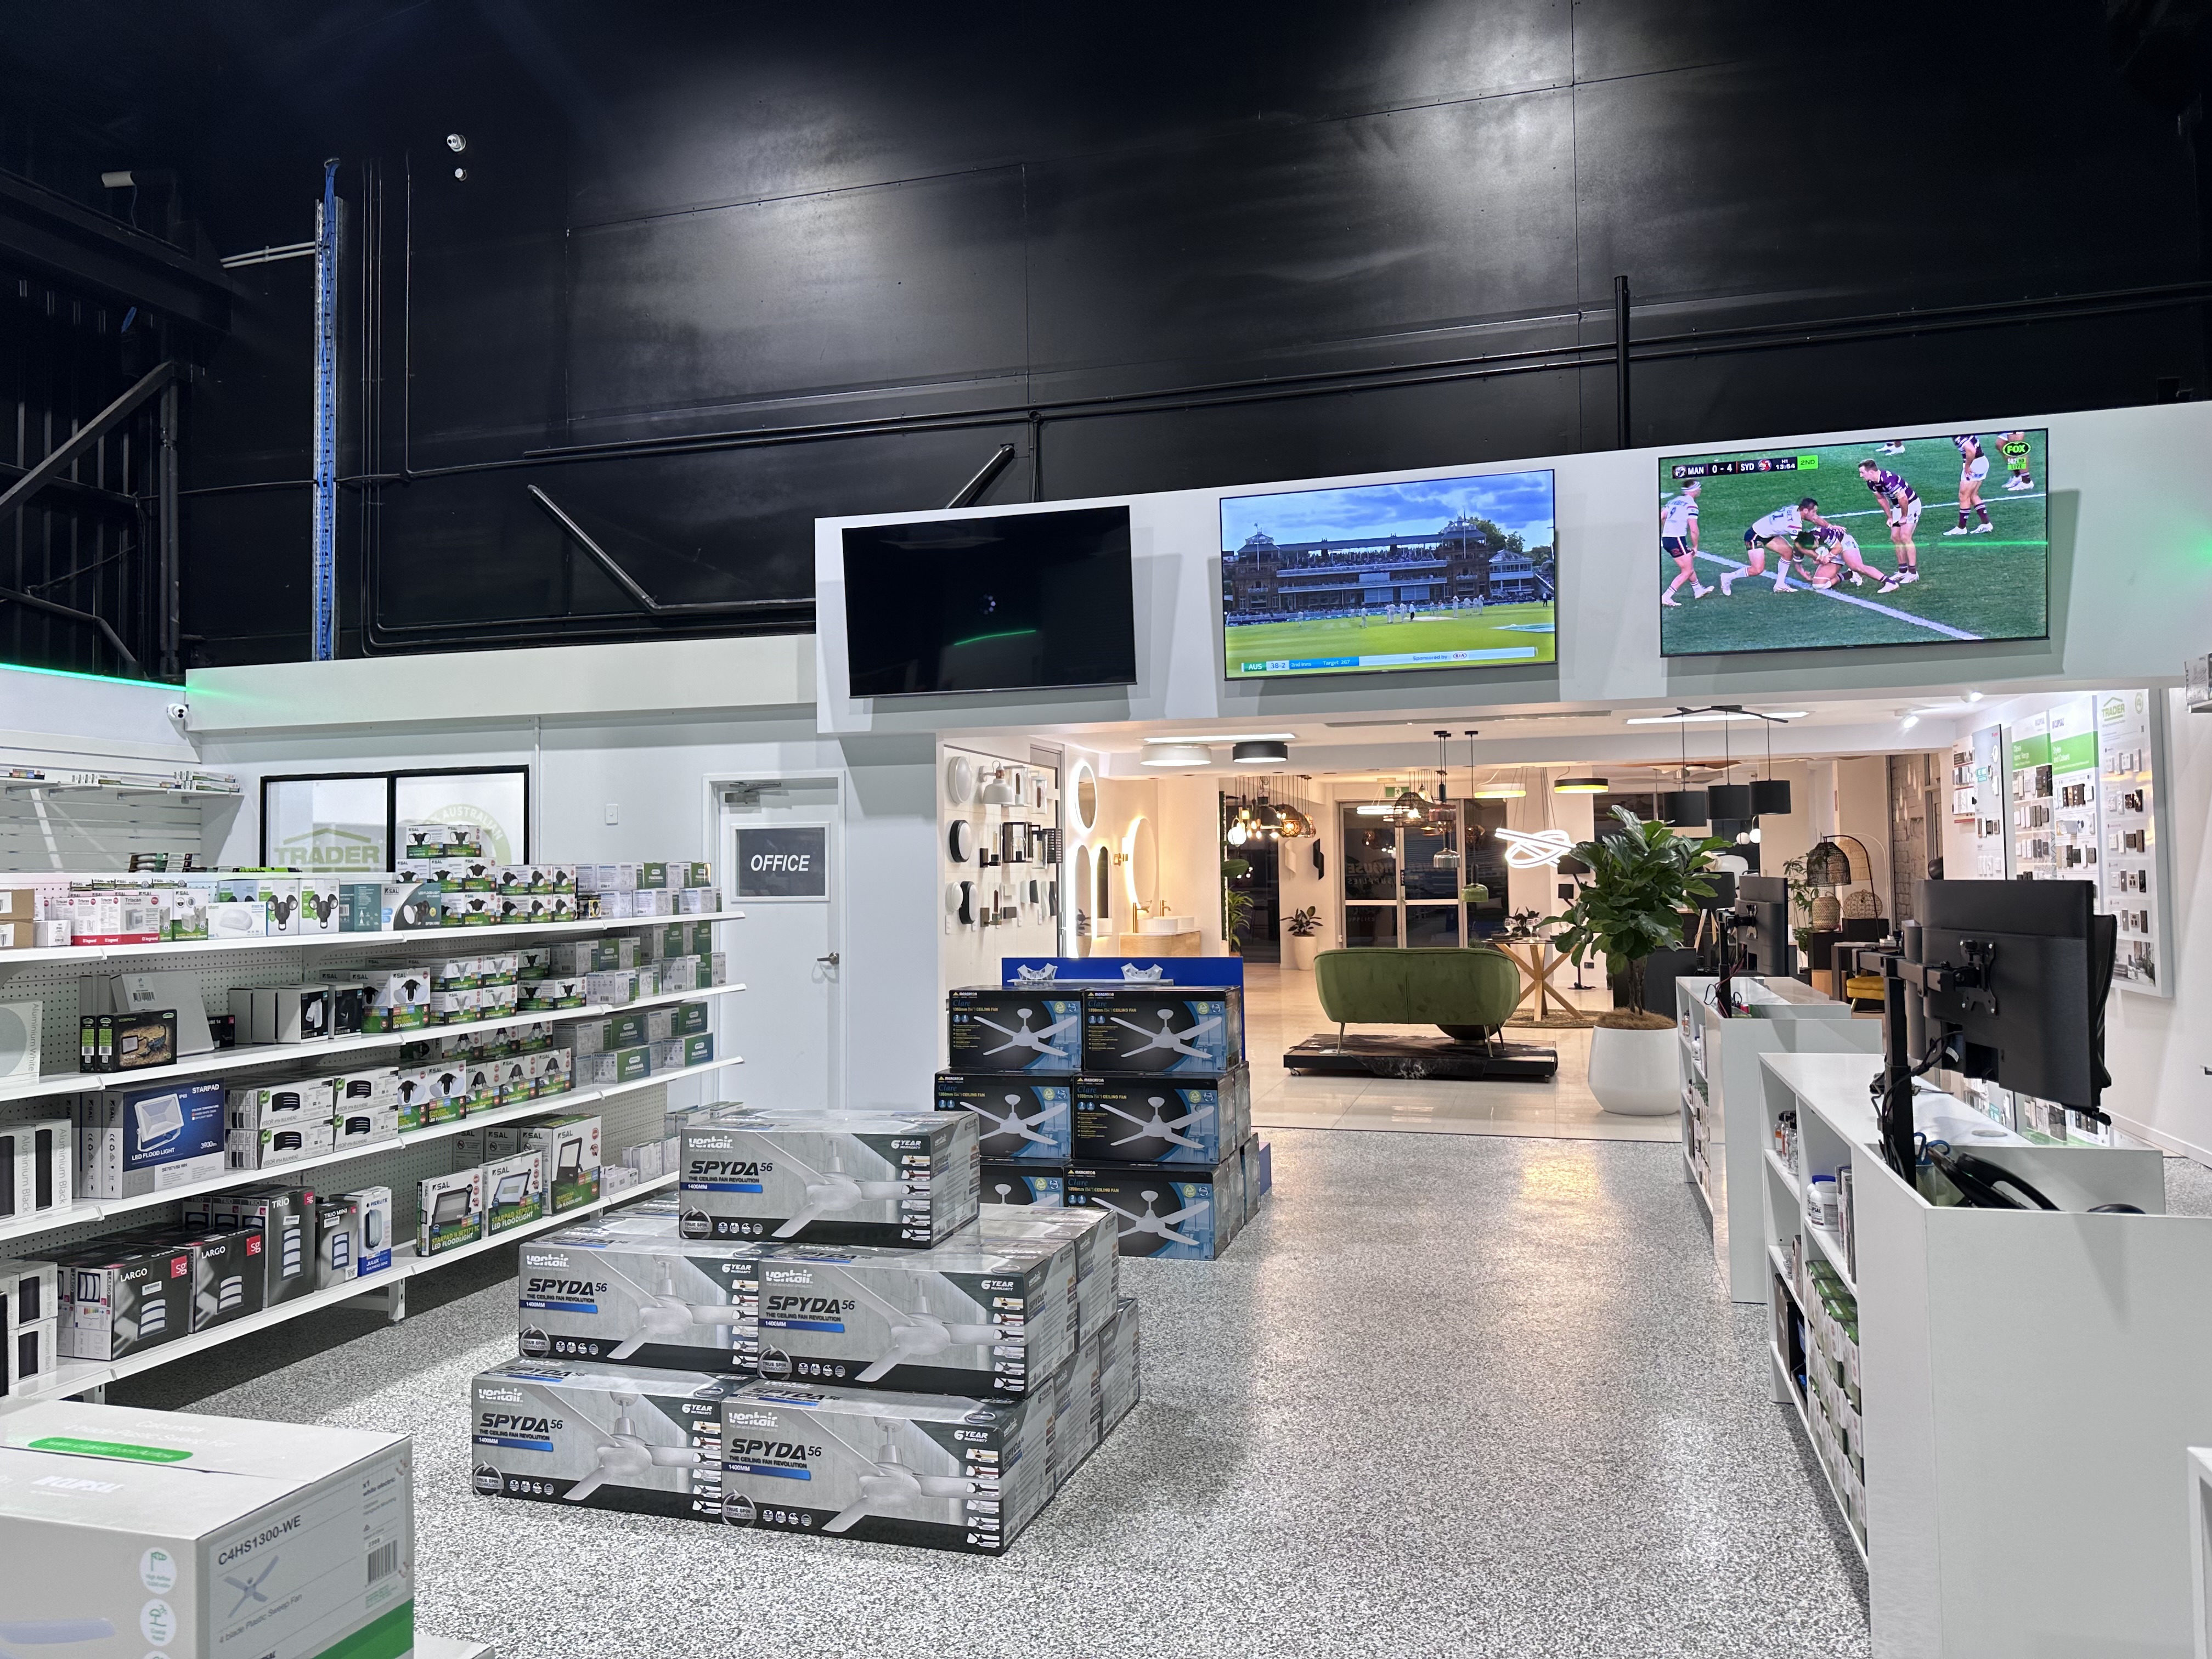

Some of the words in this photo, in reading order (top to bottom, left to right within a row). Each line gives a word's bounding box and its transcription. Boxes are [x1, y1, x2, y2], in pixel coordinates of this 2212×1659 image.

[2007, 445, 2025, 453] FOX
[2102, 702, 2125, 718] TRADER
[443, 806, 504, 840] AUSTRALIAN
[274, 846, 379, 865] TRADER
[751, 855, 810, 872] OFFICE
[30, 1003, 39, 1048] Aluminium
[193, 1084, 219, 1093] STARPAD
[689, 1136, 733, 1149] ventair
[891, 1140, 900, 1149] 6
[21, 1135, 30, 1186] Aluminium
[143, 1150, 160, 1159] FLOOD
[492, 1166, 510, 1175] SAL
[690, 1160, 759, 1176] SPYDA
[760, 1163, 772, 1172] 56
[432, 1181, 450, 1190] SAL
[272, 1198, 290, 1209] TRIO
[306, 1194, 313, 1204] sg
[371, 1198, 387, 1206] PIERLITE
[492, 1211, 515, 1223] STARPAD
[516, 1206, 533, 1217] SE7071
[502, 1211, 533, 1227] FLOODLIGHT
[432, 1233, 453, 1244] STARPAD
[442, 1233, 473, 1246] FLOODLIGHT
[201, 1245, 225, 1259] LARGO
[250, 1240, 261, 1253] sg
[366, 1258, 379, 1266] JULUX
[526, 1254, 569, 1267] ventair
[120, 1268, 148, 1282] LARGO
[176, 1262, 187, 1275] sg
[722, 1264, 731, 1273] 6
[766, 1269, 812, 1284] ventair
[527, 1278, 594, 1296] SPYDA
[595, 1283, 607, 1292] 56
[981, 1280, 991, 1290] 6
[767, 1296, 840, 1314] SPYDA
[842, 1300, 855, 1310] 56
[495, 1365, 572, 1377] SPYDA
[478, 1388, 523, 1402] ventair
[681, 1404, 691, 1413] 6
[480, 1413, 549, 1432] SPYDA
[551, 1419, 563, 1429] 56
[729, 1412, 778, 1427] ventair
[954, 1430, 964, 1440] 6
[730, 1438, 806, 1460] SPYDA
[808, 1446, 822, 1457] 56
[363, 1480, 370, 1489] x1
[363, 1487, 377, 1497] white
[377, 1477, 396, 1492] electric
[218, 1515, 301, 1565] C4HS1300-WE
[225, 1627, 244, 1641] blade
[246, 1614, 266, 1630] Plastic
[268, 1602, 290, 1618] Sweep
[291, 1594, 302, 1604] Fan
